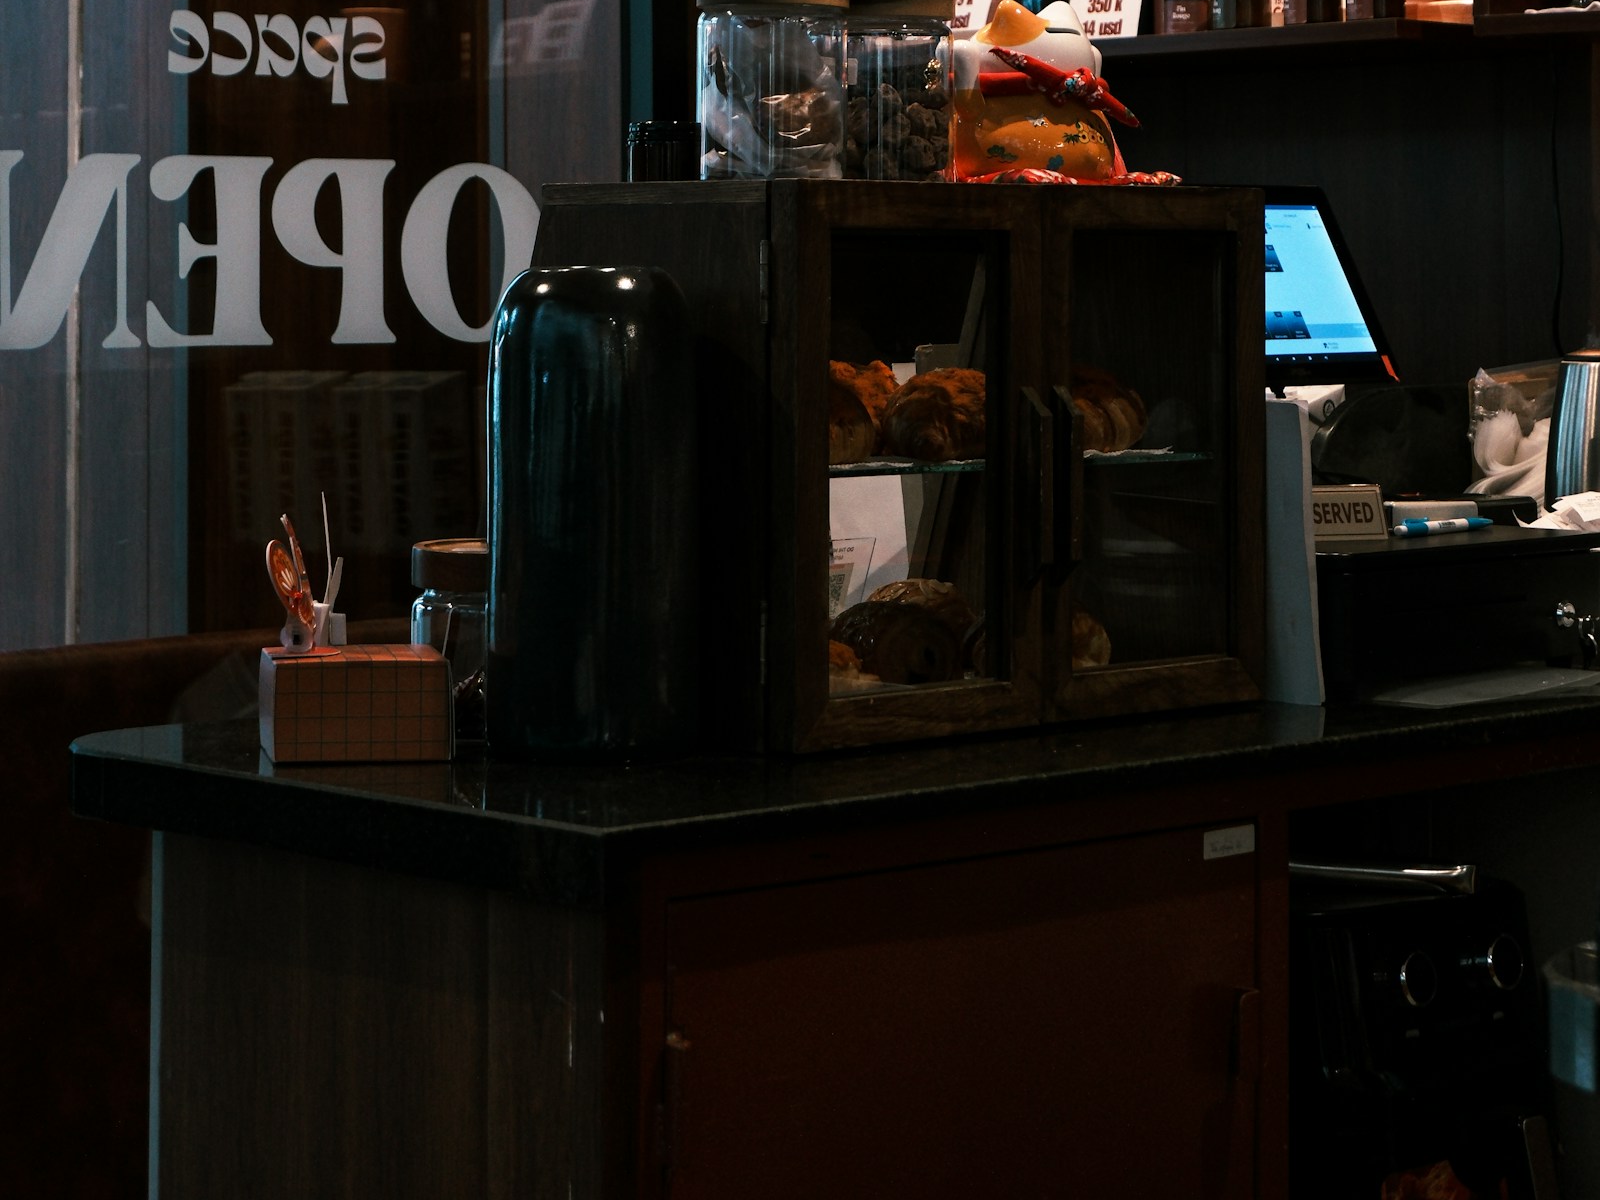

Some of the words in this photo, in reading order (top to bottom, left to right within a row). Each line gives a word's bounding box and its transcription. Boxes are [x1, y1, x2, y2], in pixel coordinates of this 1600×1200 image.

[951, 12, 970, 29] usd
[1083, 20, 1096, 36] 14
[1099, 19, 1123, 36] usd
[1313, 502, 1374, 524] SERVED
